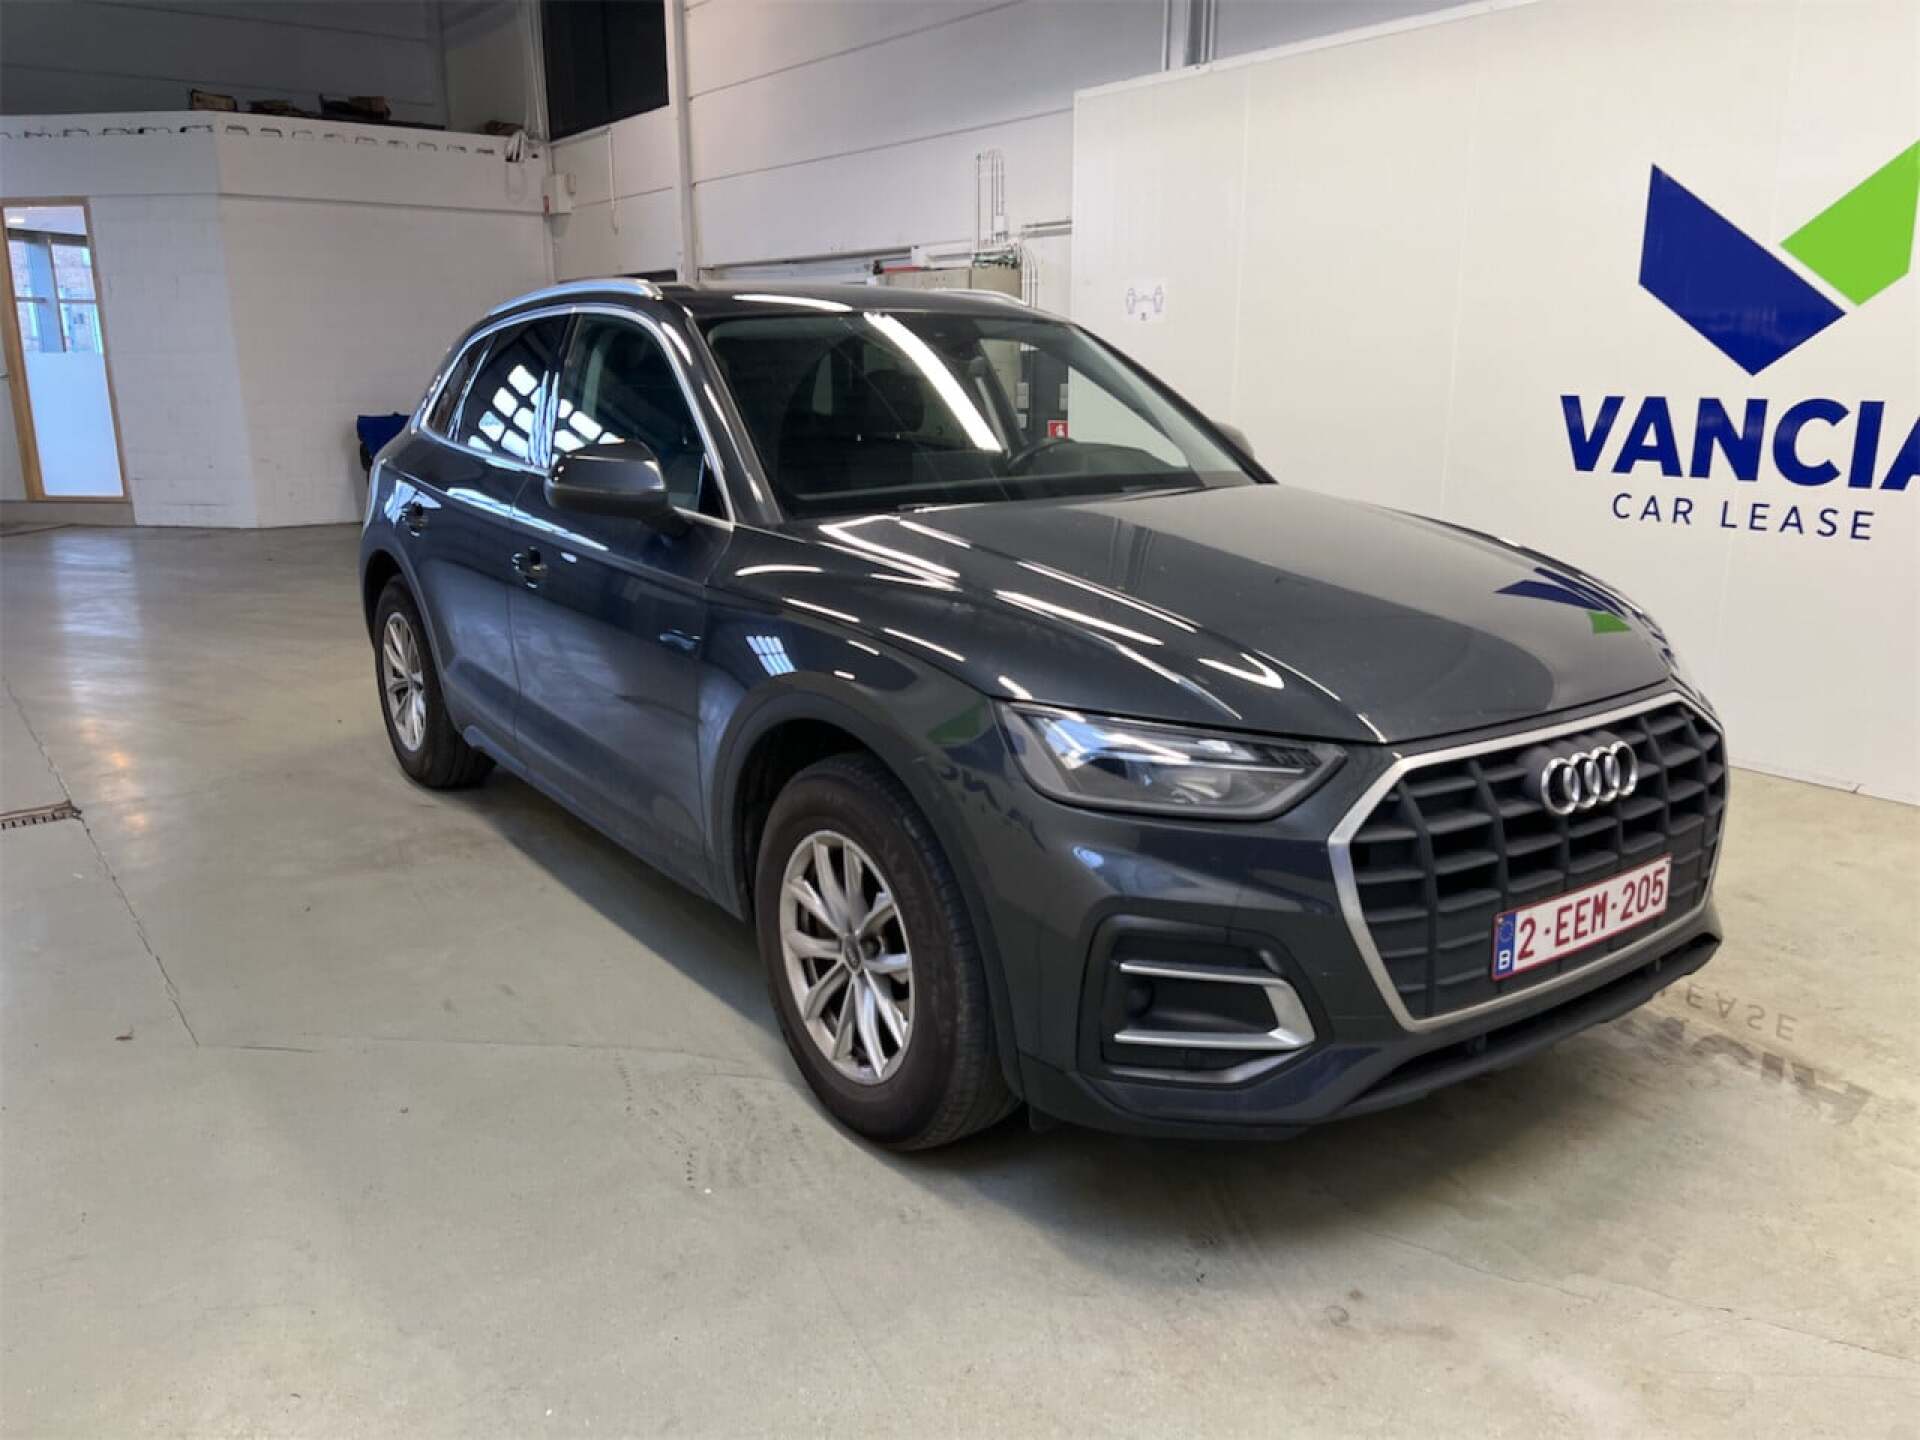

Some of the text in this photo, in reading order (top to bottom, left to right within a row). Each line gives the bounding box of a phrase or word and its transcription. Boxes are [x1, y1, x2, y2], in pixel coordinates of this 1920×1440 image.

[1612, 493, 1875, 540] CAR LEASE
[1498, 950, 1511, 970] B
